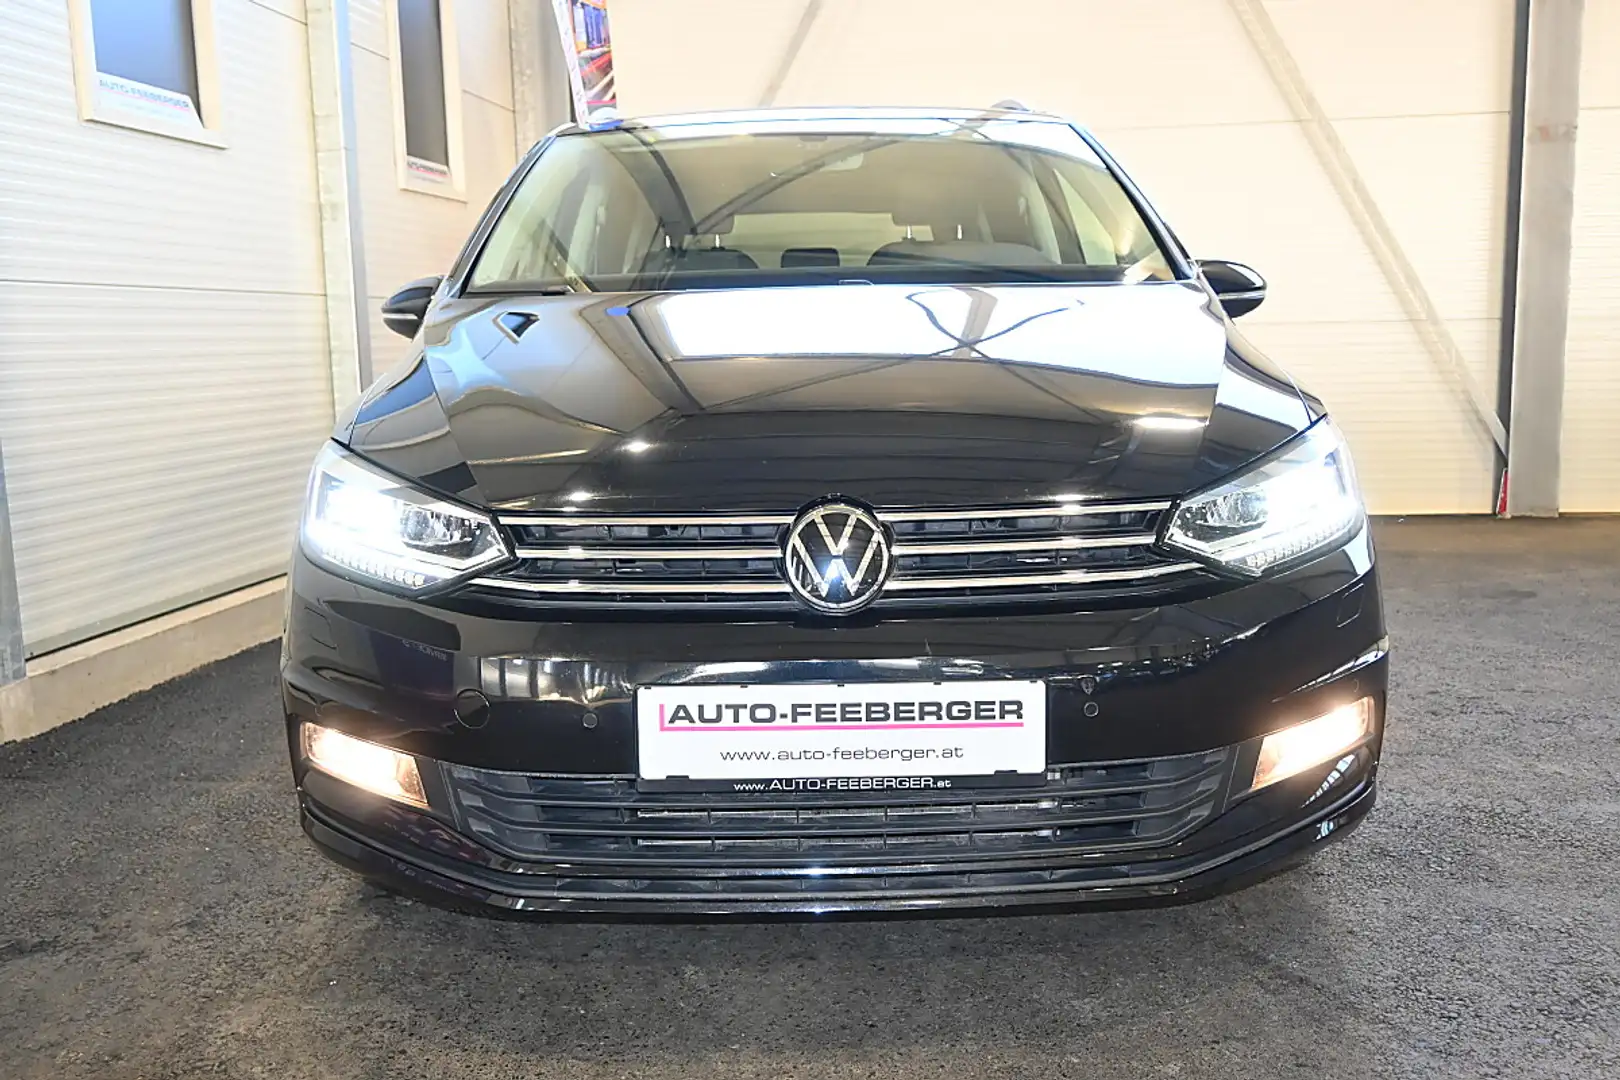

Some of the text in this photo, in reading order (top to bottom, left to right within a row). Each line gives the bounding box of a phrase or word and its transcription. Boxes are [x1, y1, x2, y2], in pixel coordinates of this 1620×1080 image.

[790, 510, 882, 600] VW
[668, 700, 1024, 724] AUTO-FEEBERGER
[719, 746, 964, 762] www.auto-feeberger.at
[733, 776, 952, 791] www.AUTO-FEEBERGER.at
